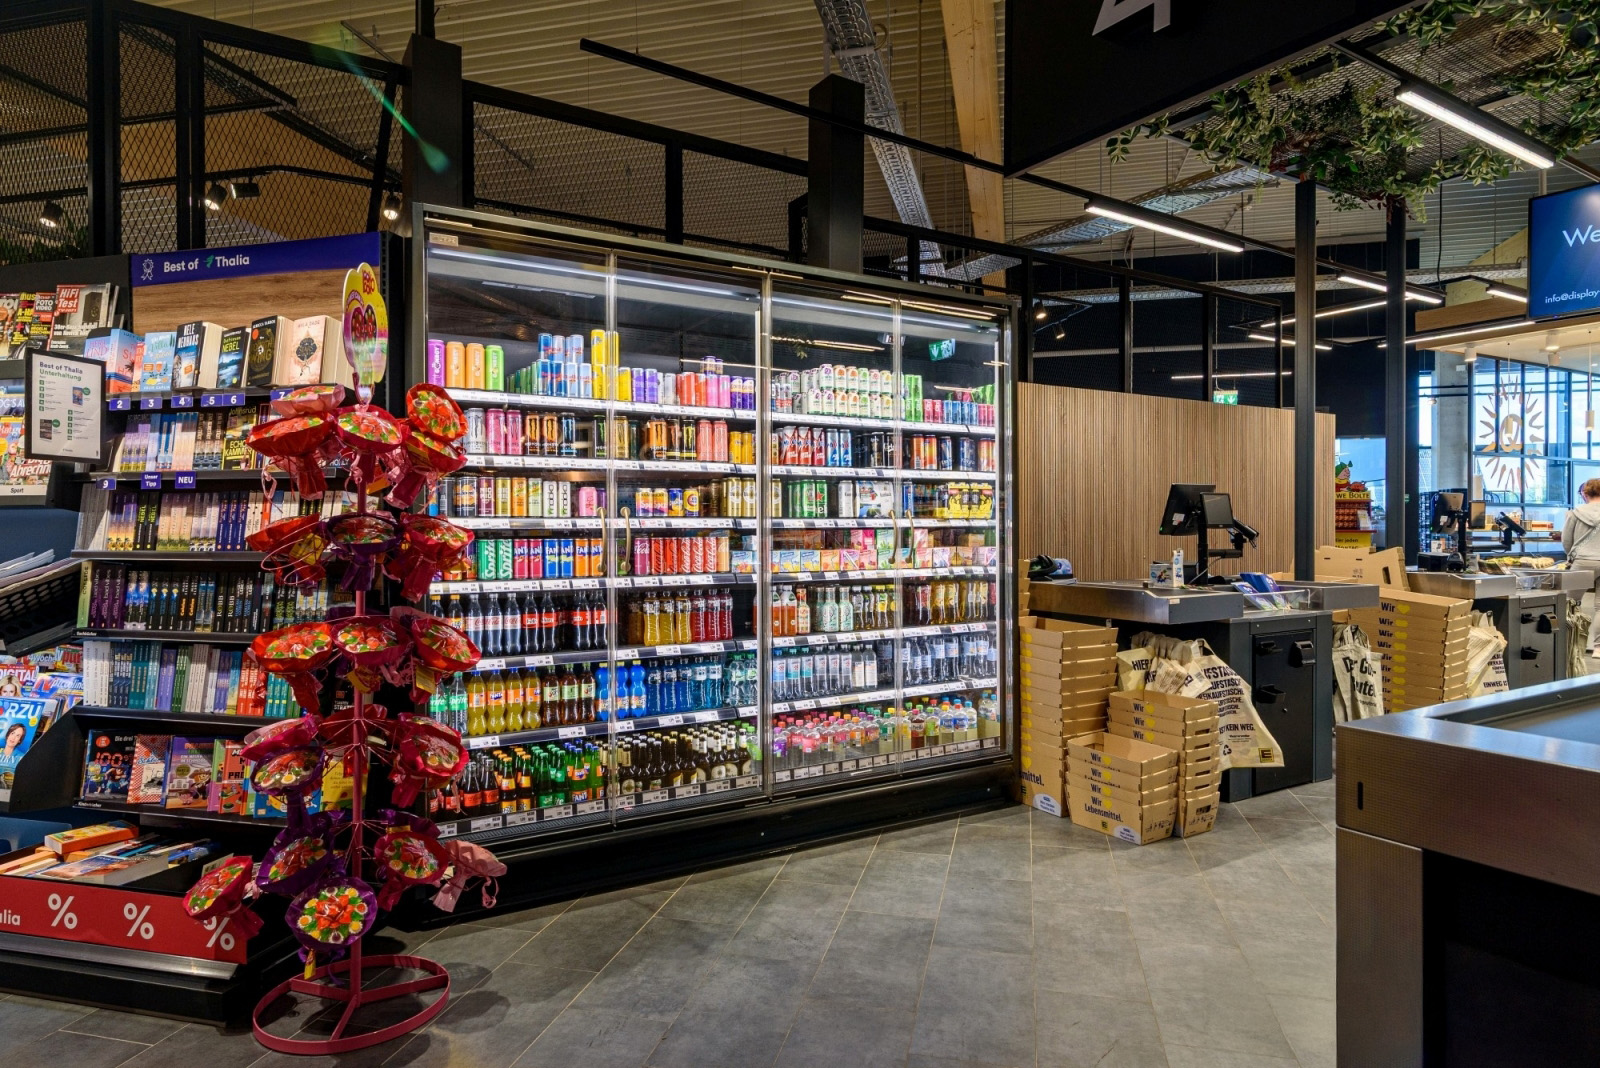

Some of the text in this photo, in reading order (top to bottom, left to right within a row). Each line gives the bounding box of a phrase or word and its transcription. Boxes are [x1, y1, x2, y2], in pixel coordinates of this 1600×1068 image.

[163, 254, 250, 273] Best of Thalia
[60, 288, 80, 299] HiFi
[58, 299, 78, 308] Test
[222, 342, 240, 353] NEBEL
[40, 361, 54, 370] Best
[64, 365, 83, 375] Thalia
[39, 368, 82, 382] Unterhaltung
[148, 399, 154, 408] 3
[178, 397, 186, 406] 4
[208, 396, 215, 405] 5
[230, 395, 237, 404] 6
[117, 400, 123, 409] 2
[102, 480, 109, 489] 9
[178, 476, 193, 485] NEU
[1380, 602, 1396, 612] Wir
[1379, 617, 1394, 626] Wir
[1378, 630, 1393, 638] Wir
[1377, 641, 1392, 649] Wir
[1133, 703, 1145, 713] Wir
[1133, 717, 1145, 726] Wir
[1225, 724, 1239, 732] KEIN
[1240, 724, 1256, 732] WEG.
[1133, 730, 1145, 740] Wir
[1091, 752, 1102, 763] Wir
[1091, 768, 1102, 778] Wir
[1091, 783, 1102, 793] Wir
[1091, 796, 1102, 807] Wir
[1084, 804, 1124, 823] Lebensmittel.
